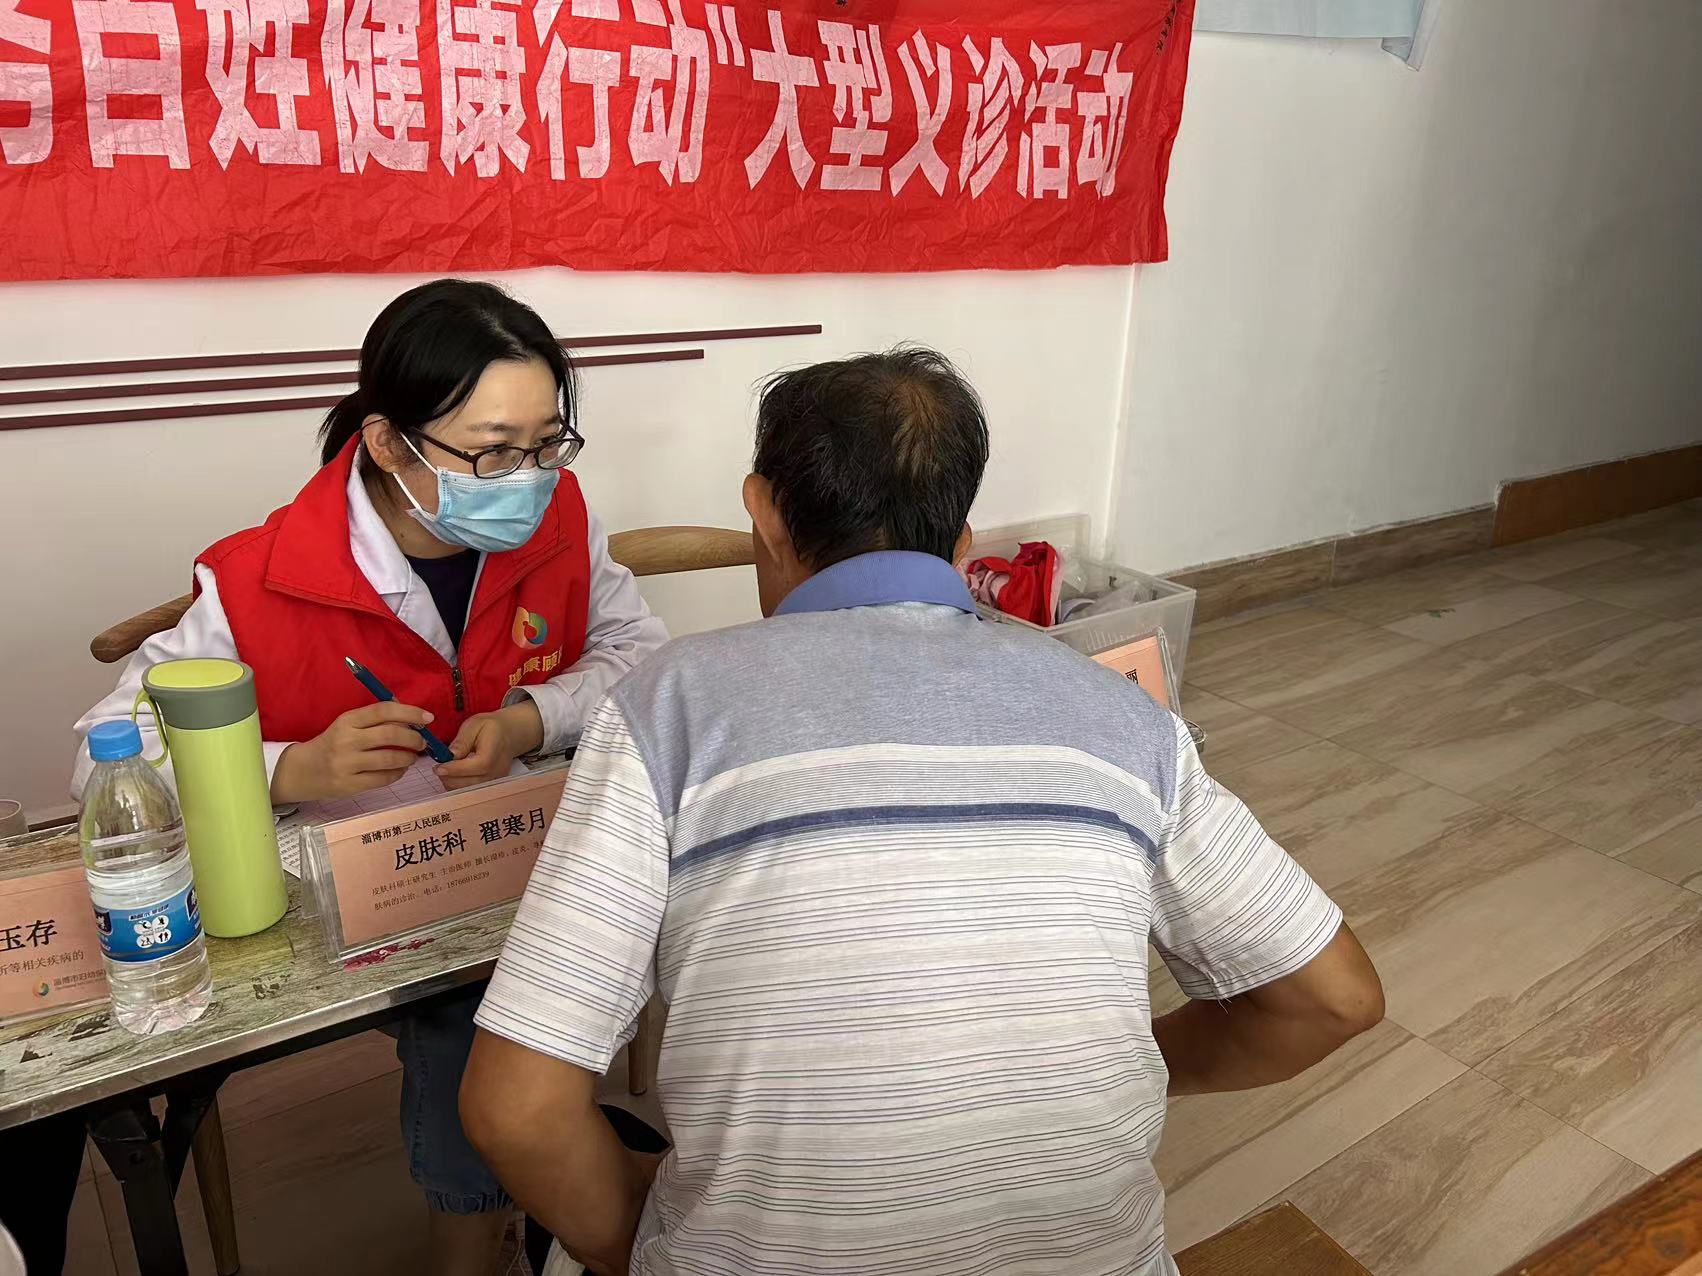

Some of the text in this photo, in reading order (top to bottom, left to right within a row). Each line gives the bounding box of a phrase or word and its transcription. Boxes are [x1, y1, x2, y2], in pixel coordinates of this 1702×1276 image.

[361, 812, 452, 845] 淄博市第三人民医院
[395, 807, 546, 871] 皮肤科 翟寒月
